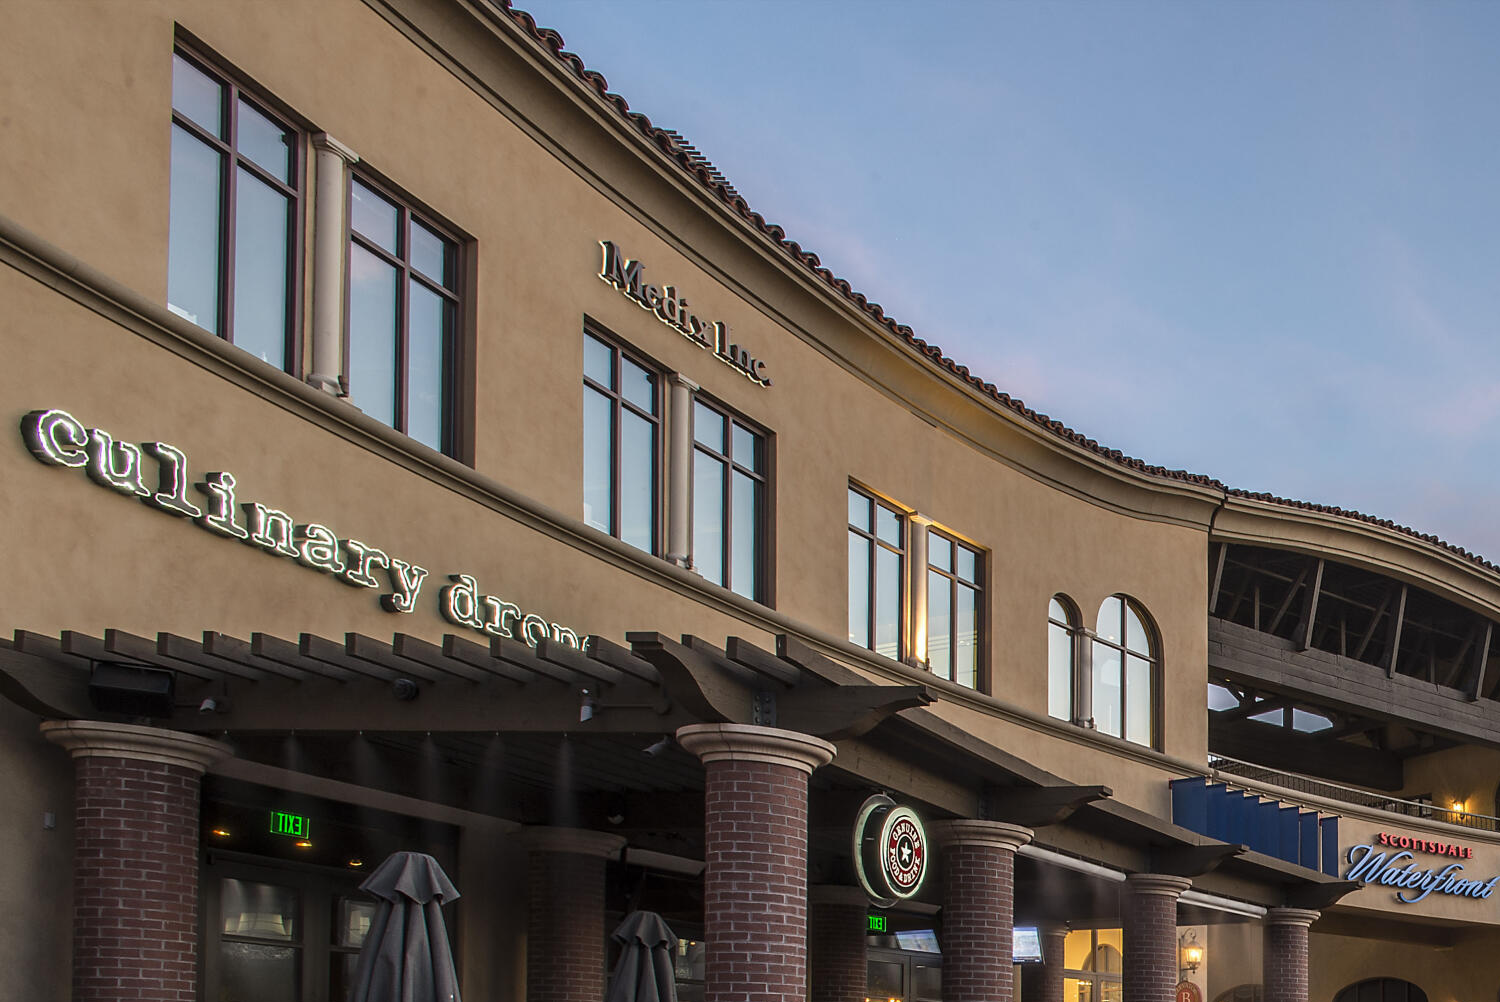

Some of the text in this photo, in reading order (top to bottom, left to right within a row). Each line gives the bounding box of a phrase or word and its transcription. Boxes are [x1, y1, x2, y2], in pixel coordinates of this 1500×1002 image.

[598, 240, 713, 349] Medix
[21, 410, 429, 614] culinary
[892, 822, 920, 849] GENUINE
[1378, 831, 1474, 860] SCOTTSDALE
[889, 847, 901, 877] FOOD
[903, 856, 921, 884] DRINK
